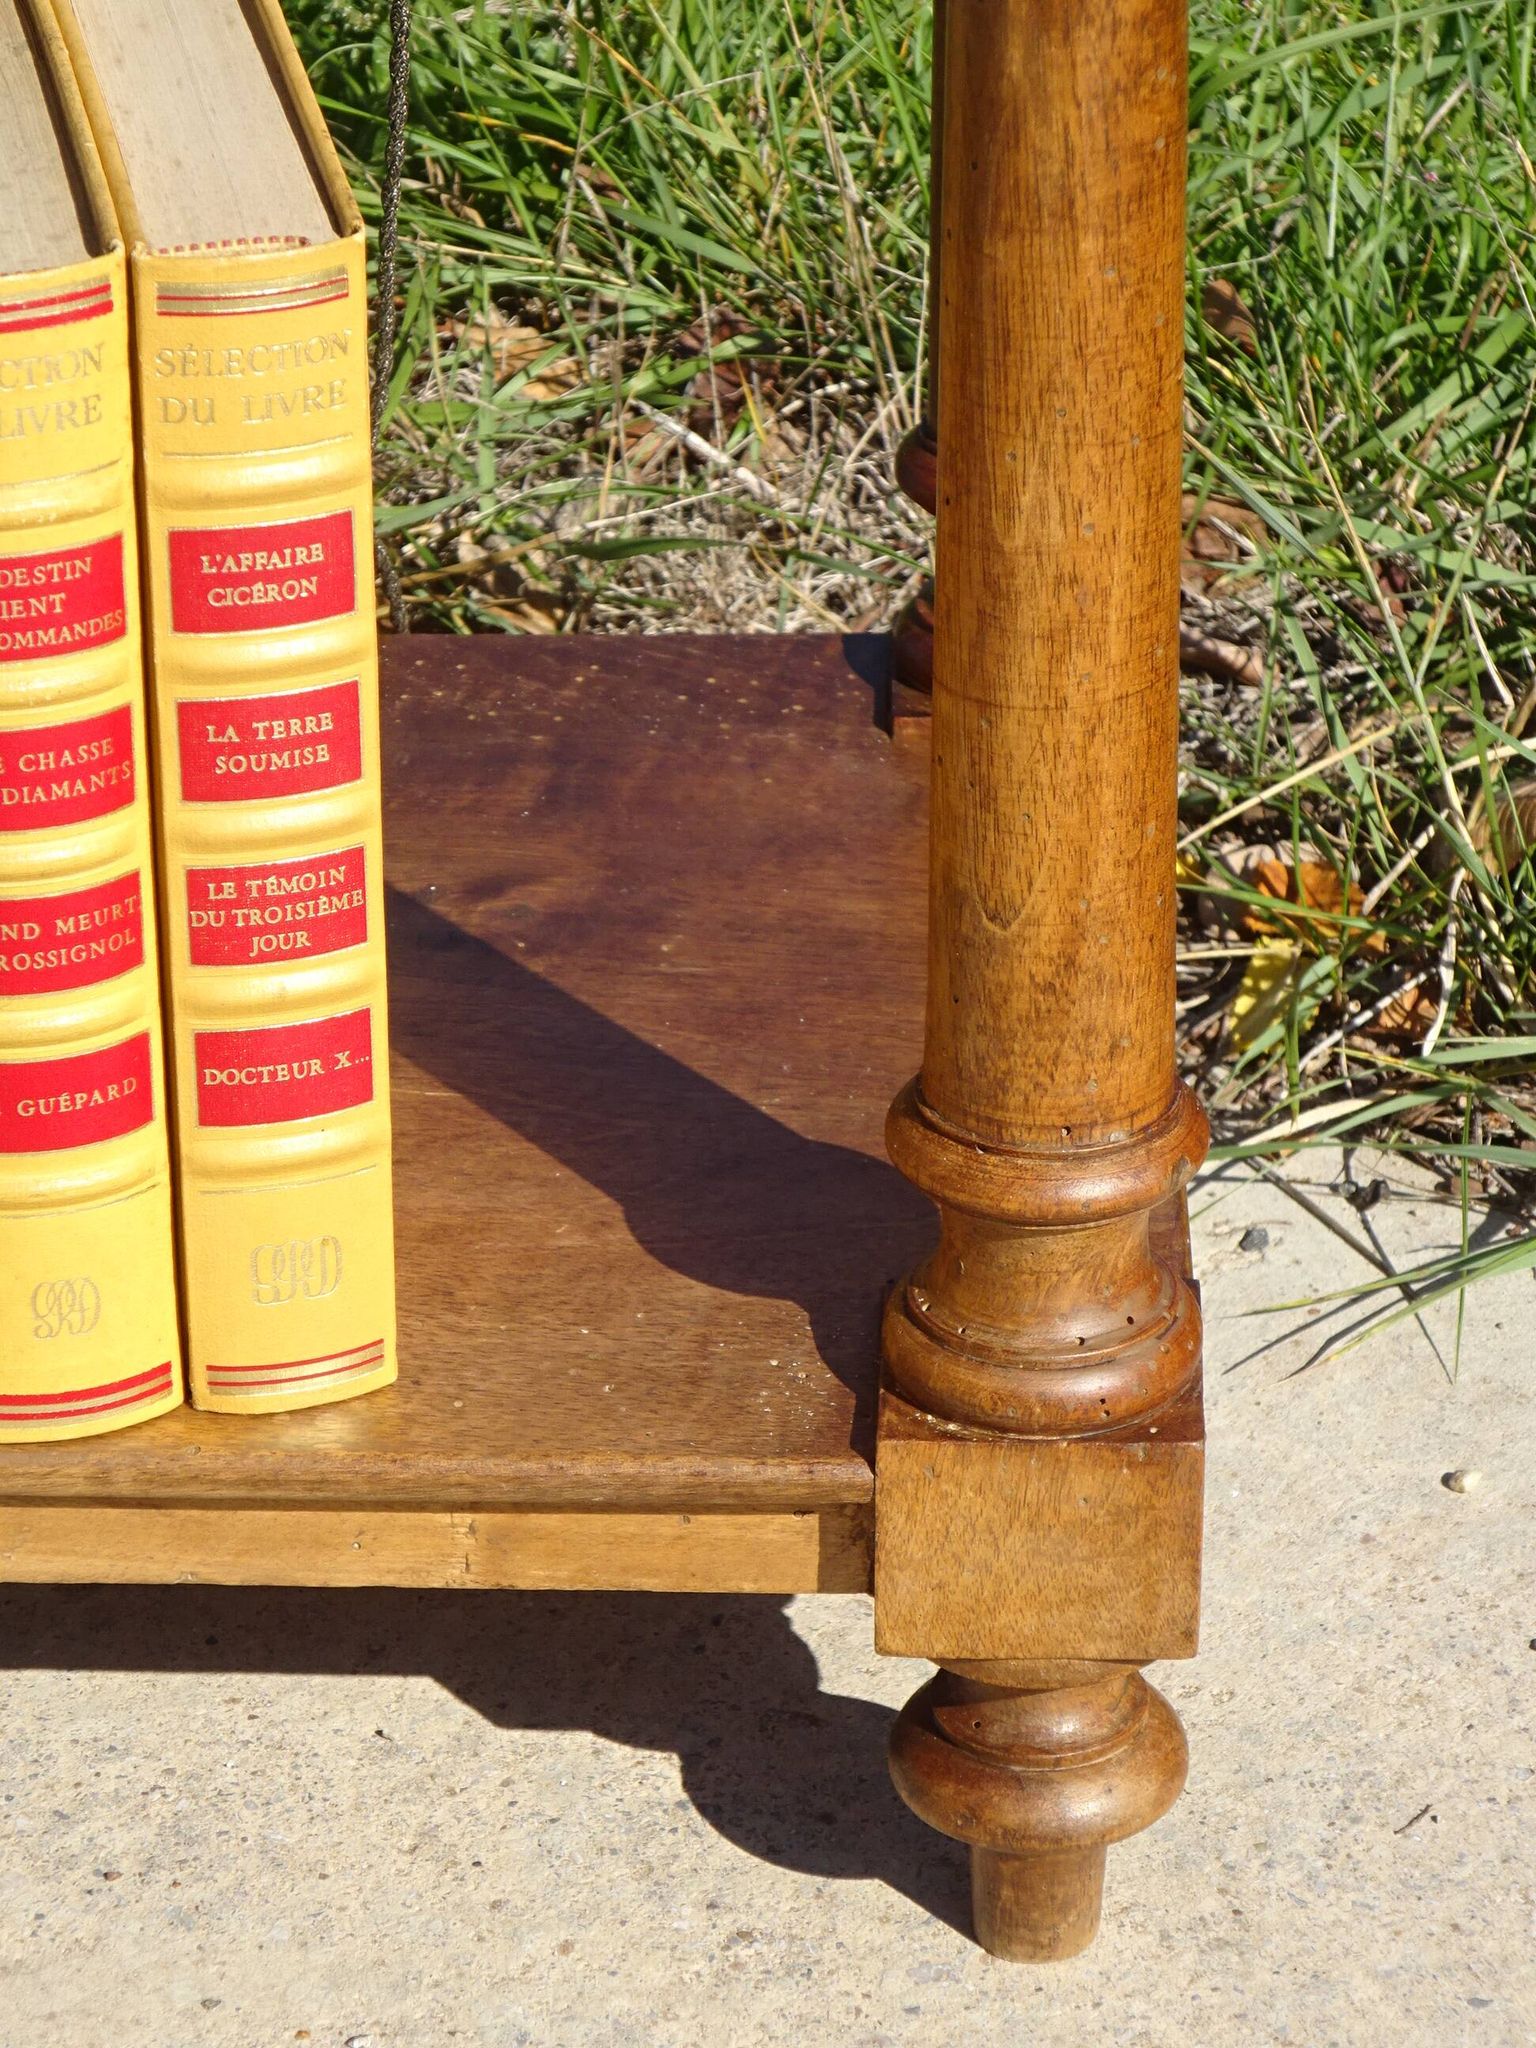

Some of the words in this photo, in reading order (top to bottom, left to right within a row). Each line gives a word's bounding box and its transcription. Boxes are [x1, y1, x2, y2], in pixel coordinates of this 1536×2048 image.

[154, 329, 352, 378] SÉLECTION
[159, 397, 216, 426] DU
[243, 379, 347, 424] LIVRE
[200, 542, 325, 574] L'AFFAIRE
[207, 576, 318, 607] CICÉRON
[207, 725, 239, 743] LA
[252, 712, 334, 740] TERRE
[18, 737, 114, 773] CHASSE
[215, 744, 331, 775] SOUMISE
[0, 760, 131, 806] DIAMANTS
[207, 881, 237, 900] LE
[245, 866, 346, 898] TÉMOIN
[54, 895, 137, 937] MEURT
[190, 910, 226, 928] DU
[231, 889, 364, 928] TROISIÈME
[249, 931, 311, 958] JOUR
[203, 1058, 325, 1087] DOCTEUR
[16, 1077, 138, 1117] GUÉPARD
